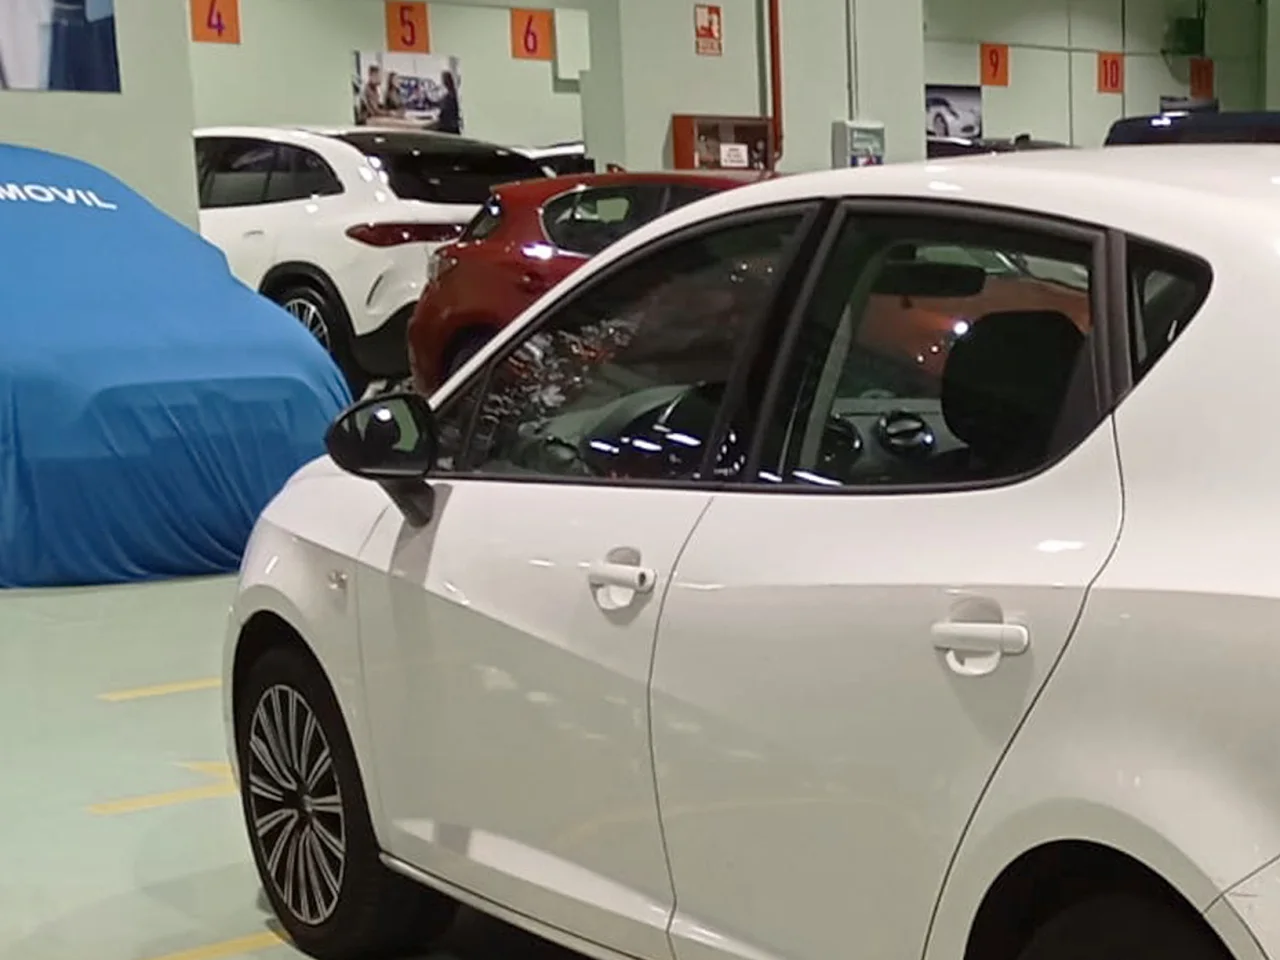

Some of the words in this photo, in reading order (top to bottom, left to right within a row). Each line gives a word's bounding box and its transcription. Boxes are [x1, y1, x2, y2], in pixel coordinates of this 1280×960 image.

[207, 0, 225, 37] 4
[400, 5, 415, 47] 5
[524, 15, 537, 53] 6
[989, 49, 999, 79] 9
[1103, 59, 1119, 88] 10
